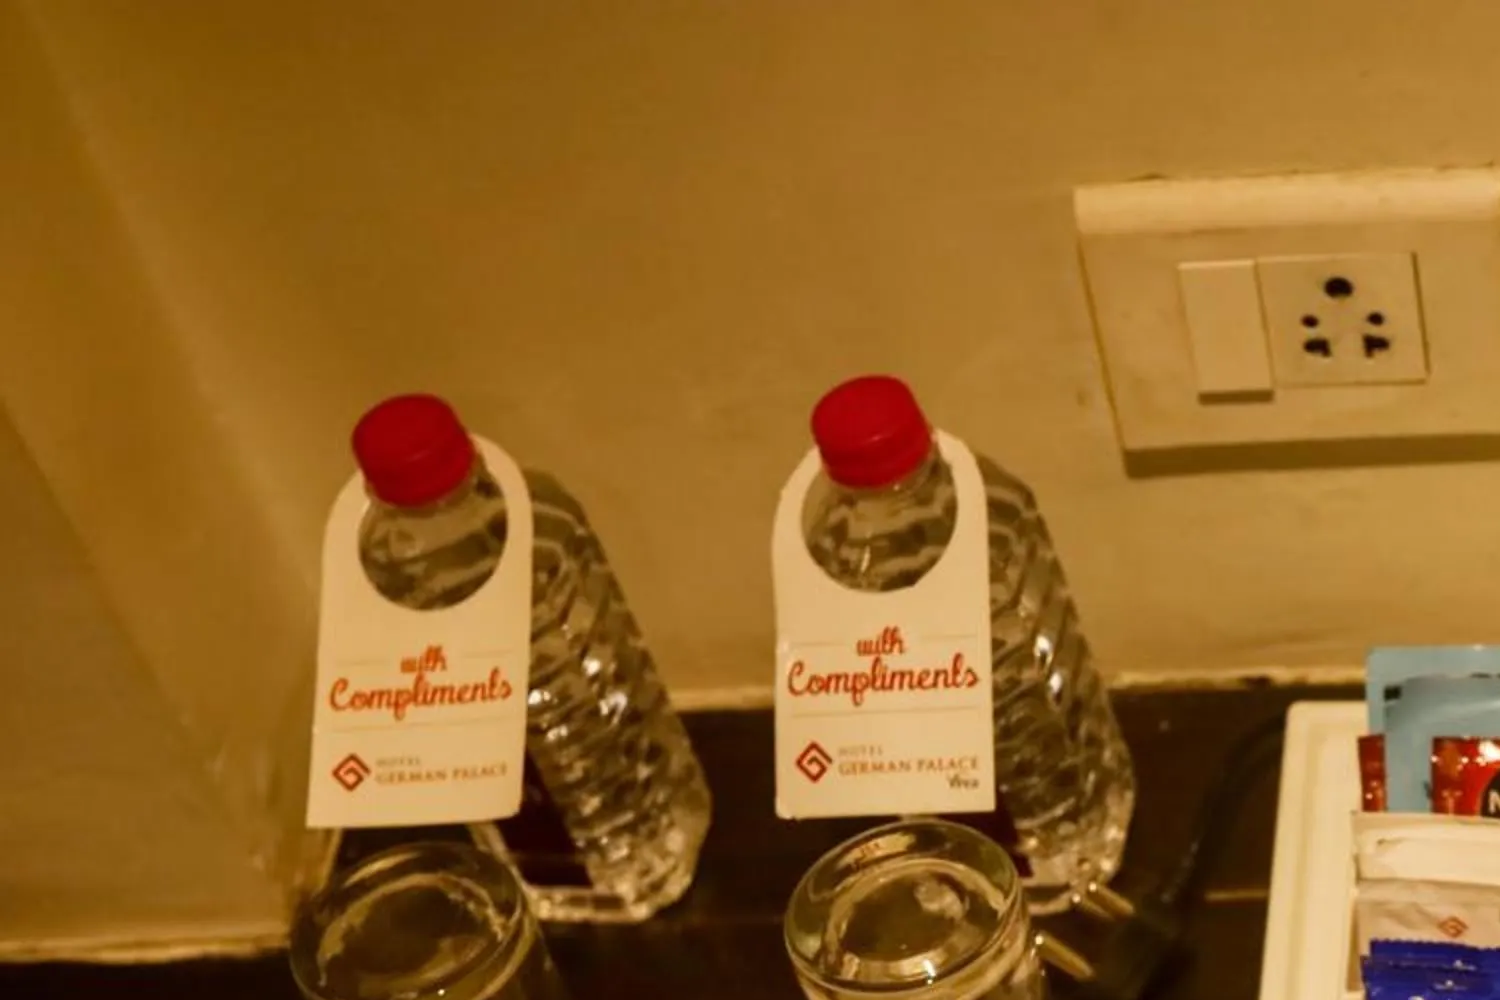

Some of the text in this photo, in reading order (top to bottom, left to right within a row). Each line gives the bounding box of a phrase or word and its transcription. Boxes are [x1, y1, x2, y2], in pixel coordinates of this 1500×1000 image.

[857, 626, 904, 656] with
[401, 645, 447, 673] with
[329, 667, 513, 721] Compliments
[788, 652, 979, 707] Compliments
[376, 761, 507, 785] GERMAN PALACE
[838, 756, 978, 776] GERMAN PALACE
